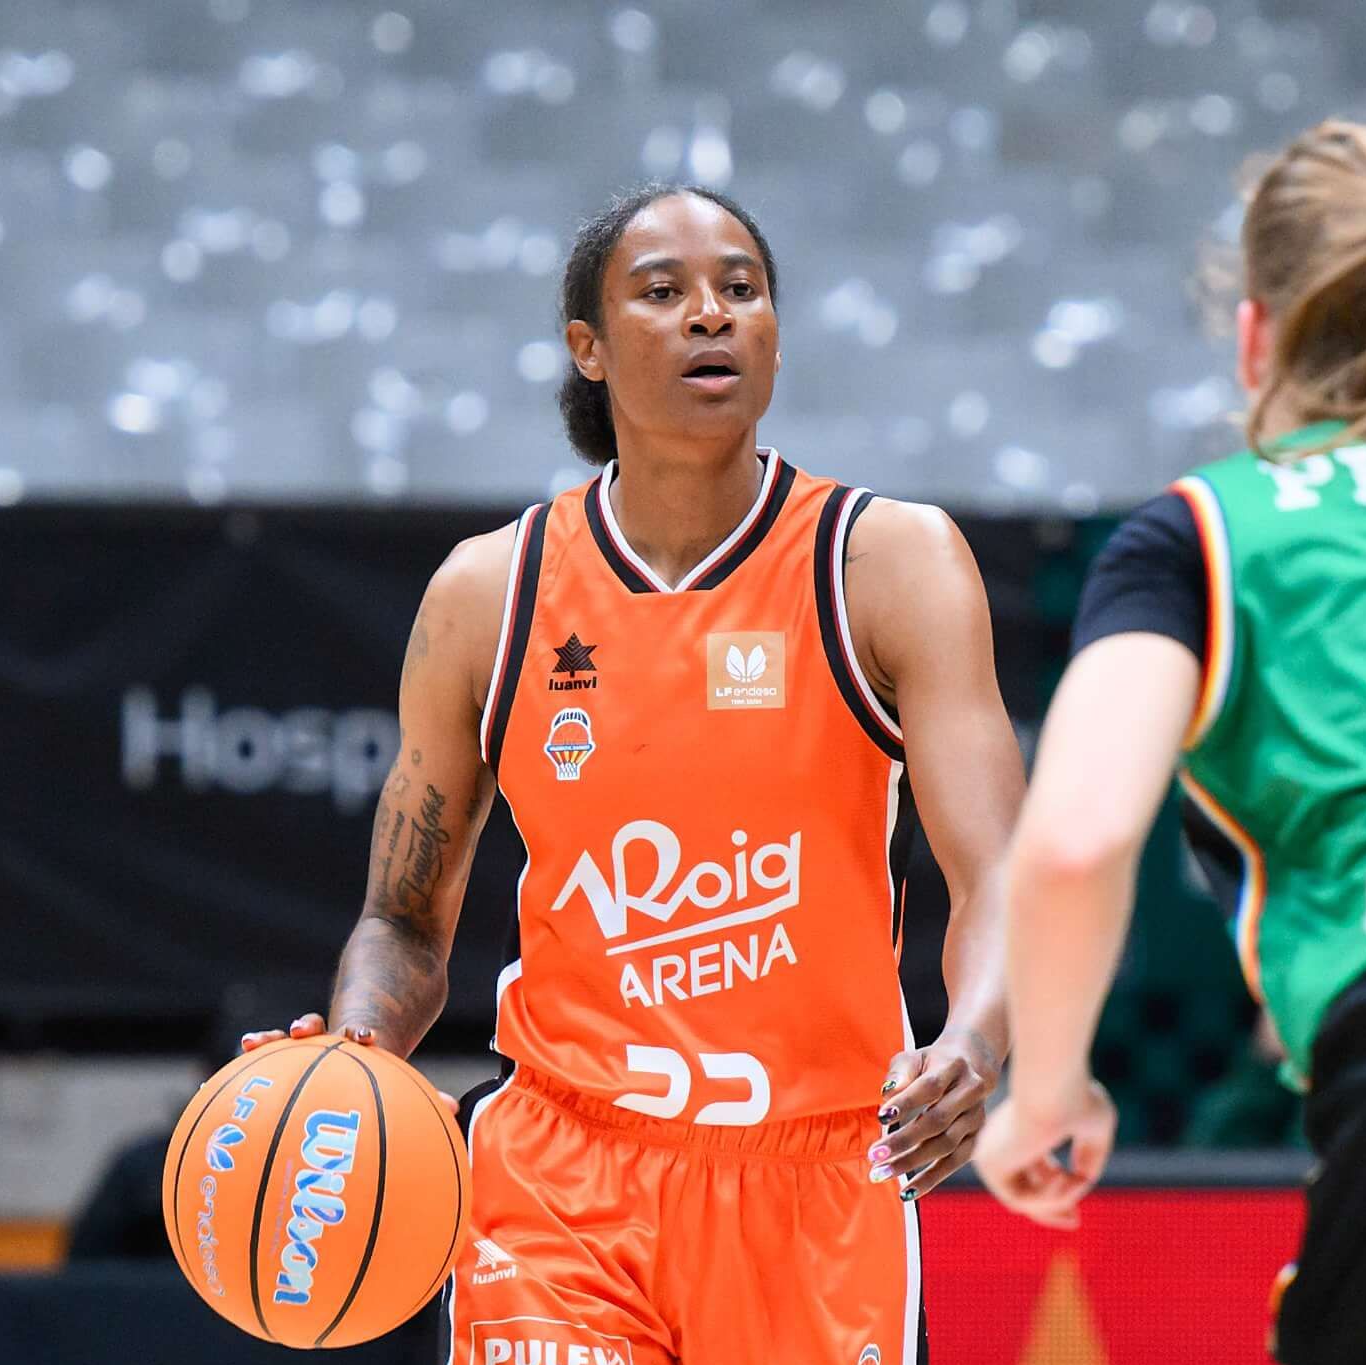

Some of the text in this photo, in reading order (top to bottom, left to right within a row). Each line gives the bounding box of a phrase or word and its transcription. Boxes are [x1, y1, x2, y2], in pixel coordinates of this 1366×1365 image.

[548, 676, 597, 691] luanvi
[121, 684, 402, 814] Hosp
[550, 818, 803, 957] Roig
[619, 922, 798, 1009] ARENA
[233, 1075, 273, 1120] LF
[273, 1109, 362, 1306] Wilson
[472, 1264, 518, 1285] luanvi
